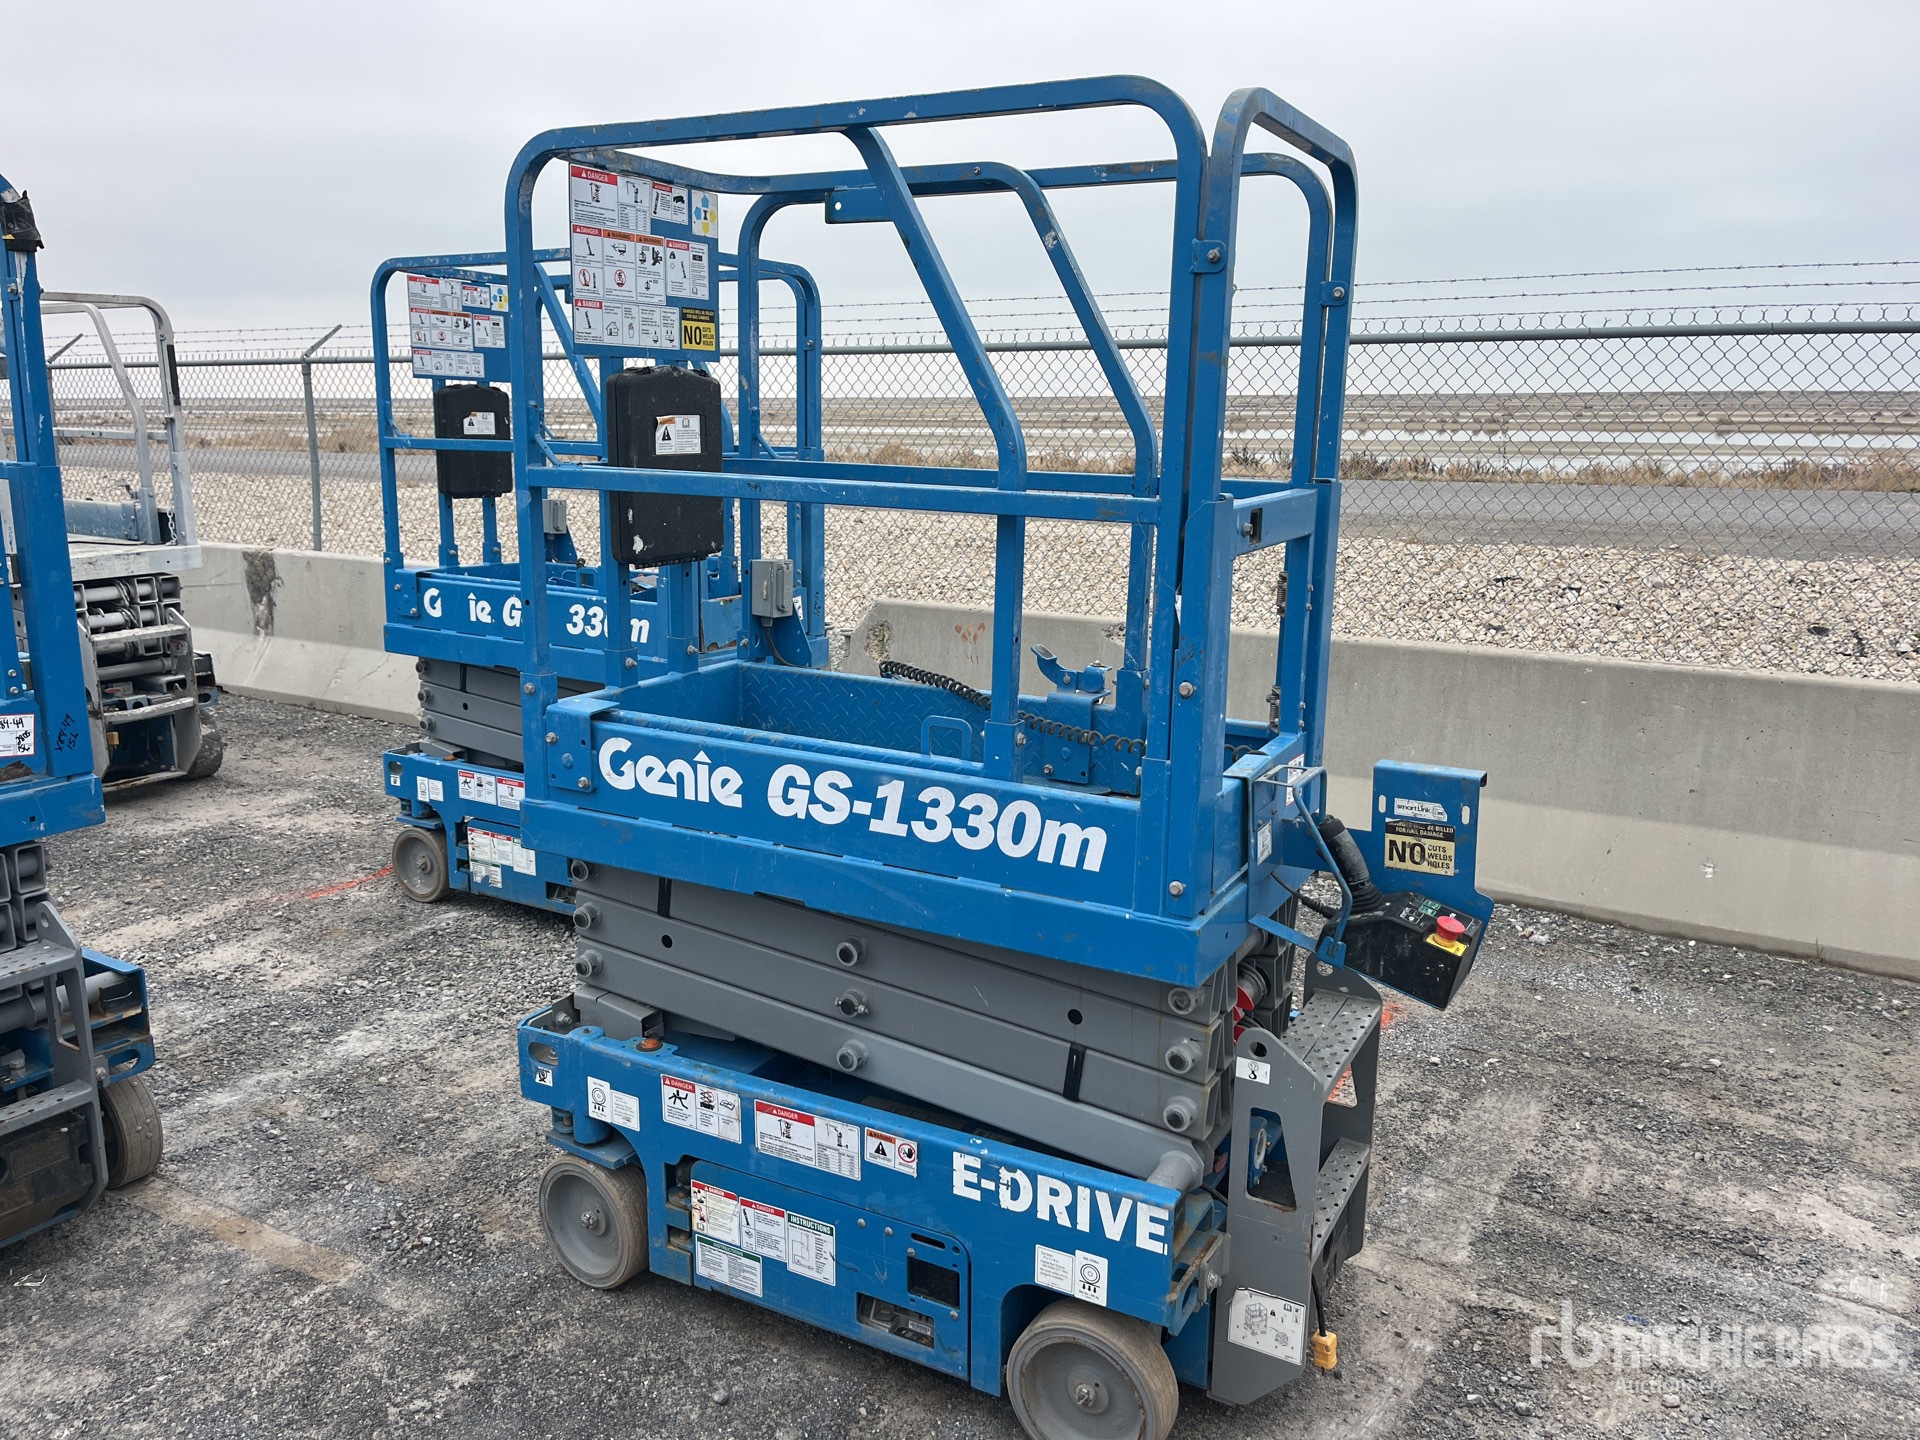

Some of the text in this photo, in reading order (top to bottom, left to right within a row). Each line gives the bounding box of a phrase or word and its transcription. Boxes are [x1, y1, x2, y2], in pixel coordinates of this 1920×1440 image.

[587, 172, 608, 182] DANGER
[581, 227, 598, 235] DANGER
[612, 231, 631, 240] WARNING
[672, 242, 687, 250] DANGER
[684, 325, 702, 345] NO
[598, 737, 1108, 872] Genie GS-1330m
[1388, 839, 1425, 866] NO
[1427, 844, 1446, 853] CUTS
[1427, 852, 1452, 862] WELDS
[1427, 861, 1450, 870] HOLES
[671, 1080, 693, 1090] DANGER
[777, 1109, 798, 1120] DANGER
[873, 1132, 893, 1143] WARNING
[708, 1187, 725, 1196] DANGER
[755, 1204, 775, 1213] DANGER
[952, 1151, 1169, 1256] E-DRIVE
[790, 1215, 831, 1234] INSTRUCTIONS
[713, 1242, 744, 1256] INSTRUCTIONS
